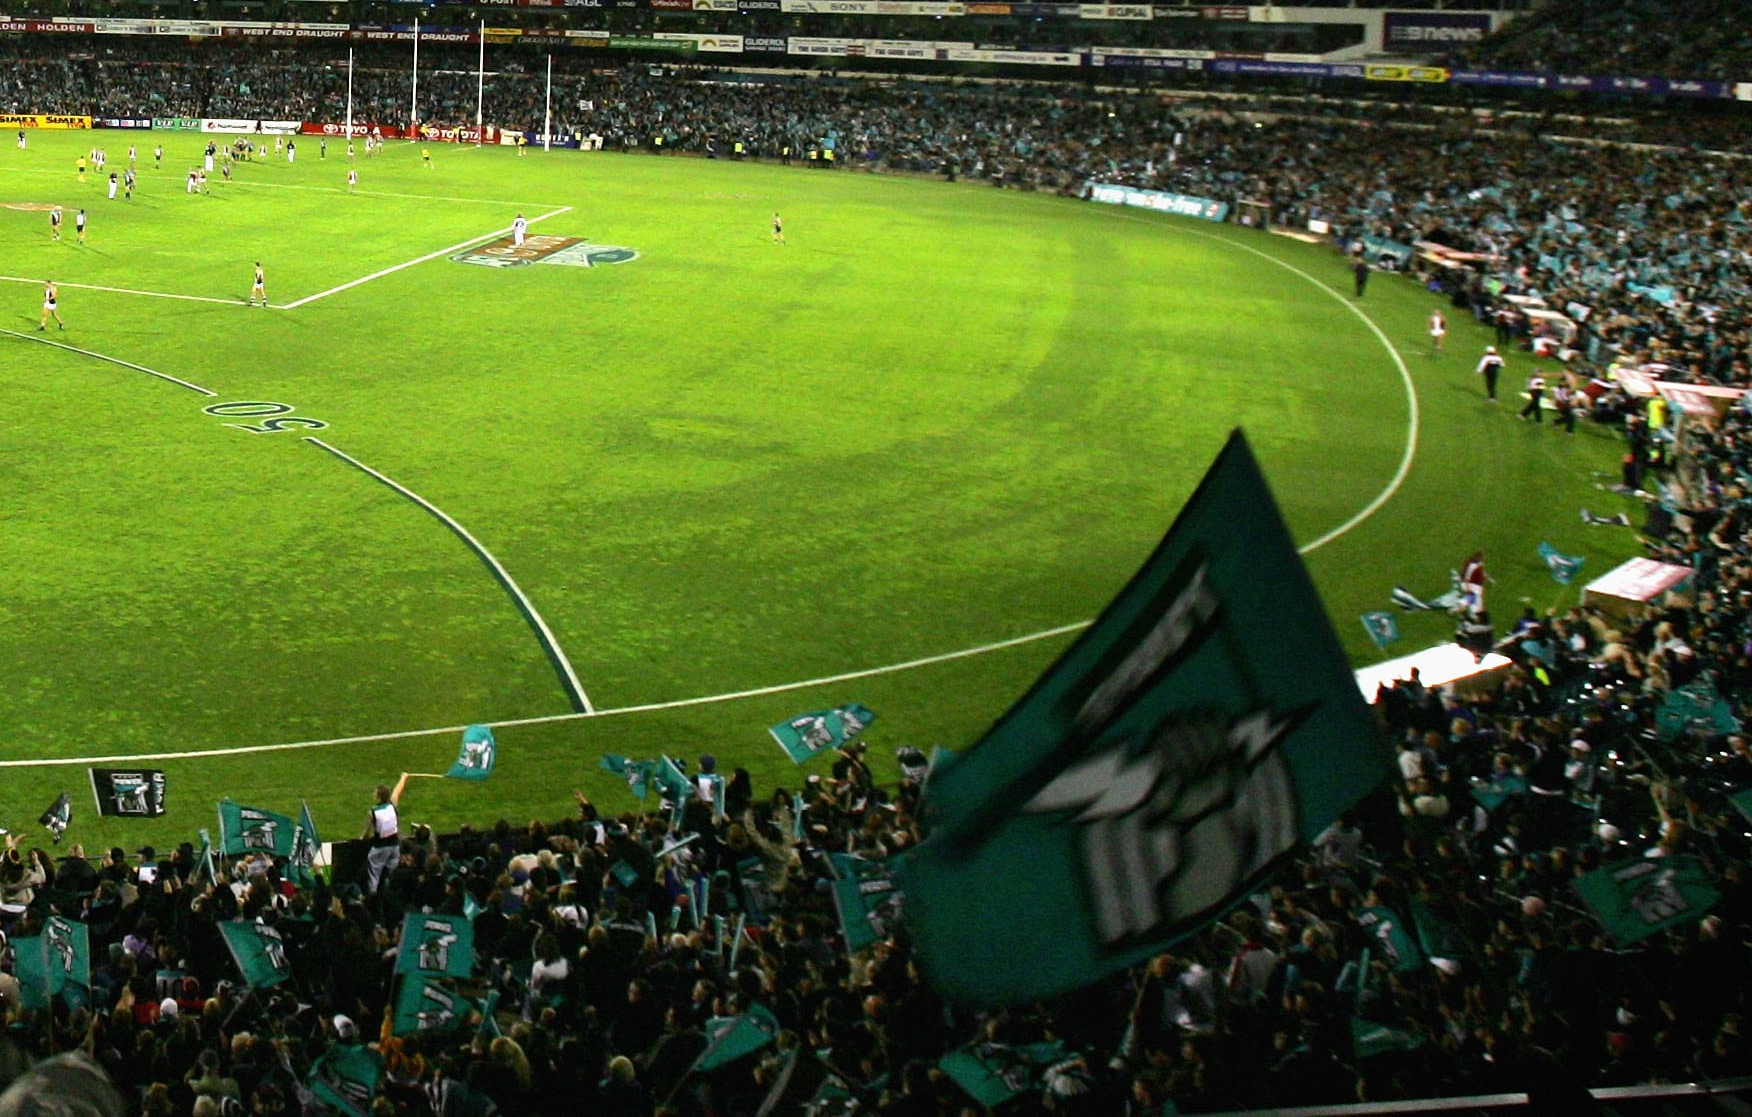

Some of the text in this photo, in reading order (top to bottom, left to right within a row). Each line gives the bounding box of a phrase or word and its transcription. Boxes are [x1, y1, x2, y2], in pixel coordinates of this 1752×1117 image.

[830, 3, 867, 11] SONY
[36, 23, 85, 32] HOLDEN
[242, 28, 345, 38] WEST END DRAUGHT
[367, 31, 396, 40] WEST
[420, 33, 470, 42] DRAUGHT
[1425, 27, 1483, 42] news
[46, 116, 84, 124] SIMEX
[201, 401, 331, 434] 50
